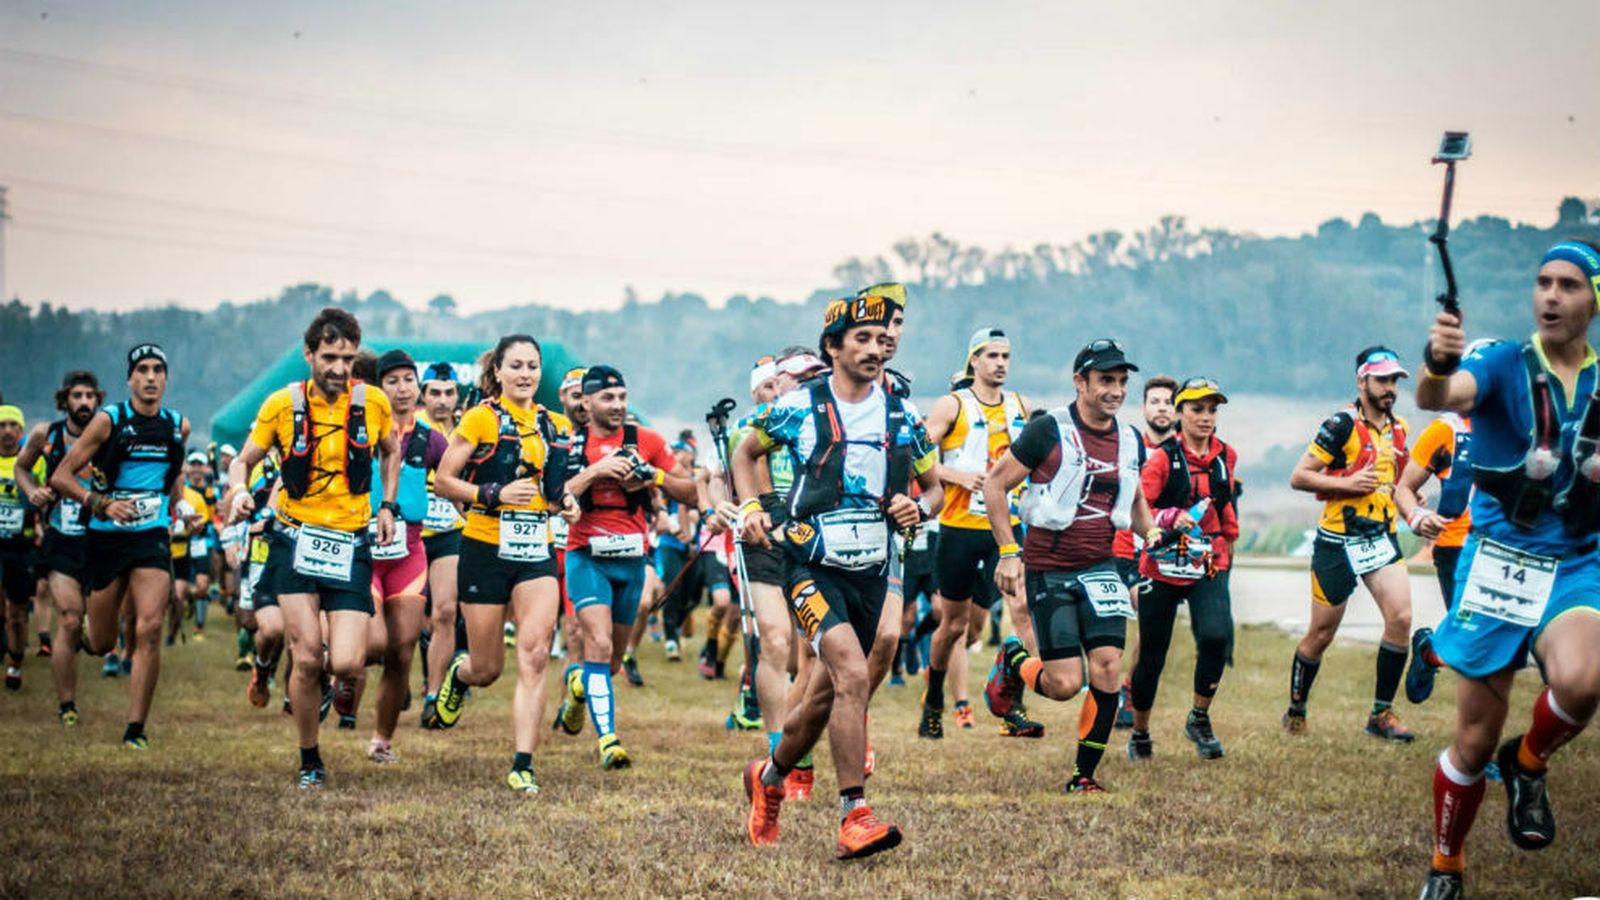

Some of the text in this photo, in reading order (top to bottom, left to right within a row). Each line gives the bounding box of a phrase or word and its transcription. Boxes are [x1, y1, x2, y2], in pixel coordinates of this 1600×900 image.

[513, 523, 538, 535] 927
[851, 525, 858, 539] 1
[312, 539, 341, 555] 926
[1502, 565, 1526, 584] 14
[1100, 583, 1117, 594] 30
